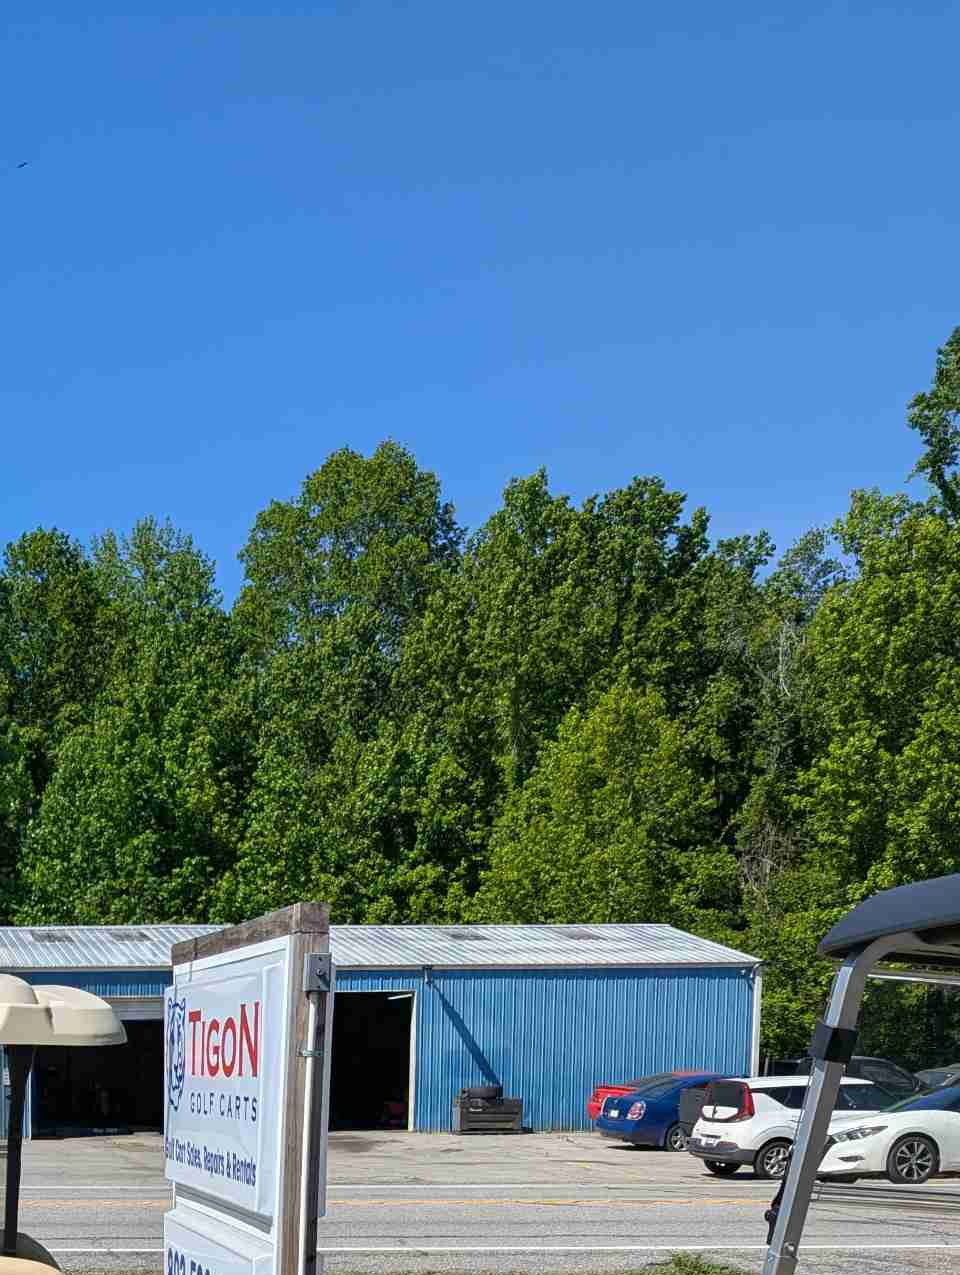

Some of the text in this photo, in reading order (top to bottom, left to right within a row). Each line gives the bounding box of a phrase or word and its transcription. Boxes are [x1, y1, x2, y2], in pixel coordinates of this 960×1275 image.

[188, 1001, 259, 1078] TIGON
[190, 1091, 257, 1122] GOLF CARTS
[203, 1145, 224, 1176] Repairs
[226, 1151, 231, 1178] &
[232, 1152, 256, 1187] Rentals
